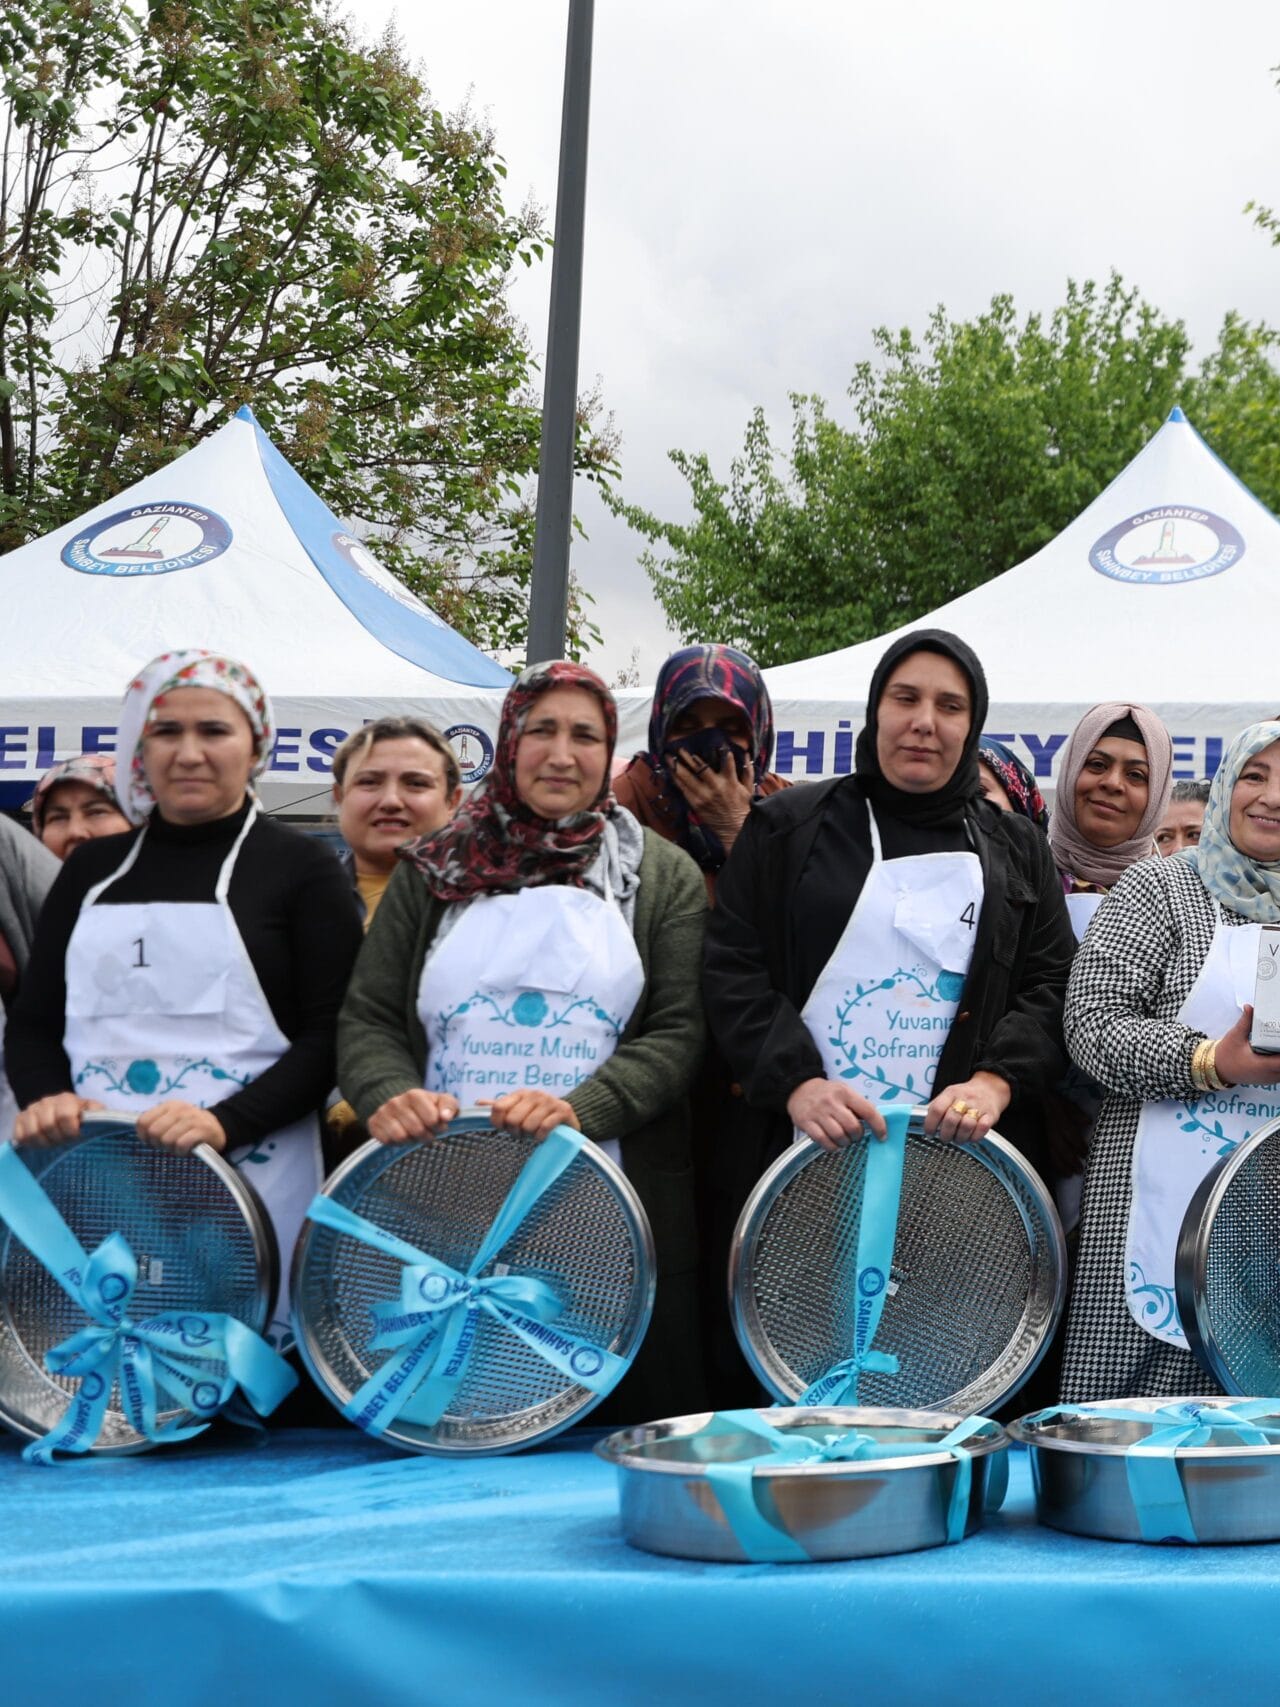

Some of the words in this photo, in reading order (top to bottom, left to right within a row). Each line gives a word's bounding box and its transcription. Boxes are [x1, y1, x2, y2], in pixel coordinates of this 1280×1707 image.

[131, 503, 209, 522] GAZİANTEP
[1132, 508, 1209, 526] GAZİANTEP
[959, 901, 976, 930] 4
[131, 937, 150, 968] 1
[462, 1033, 535, 1057] Yuvanız
[540, 1036, 597, 1060] Mutlu
[524, 1064, 593, 1087] Berek
[512, 1316, 576, 1356] ŞAHİNBEY
